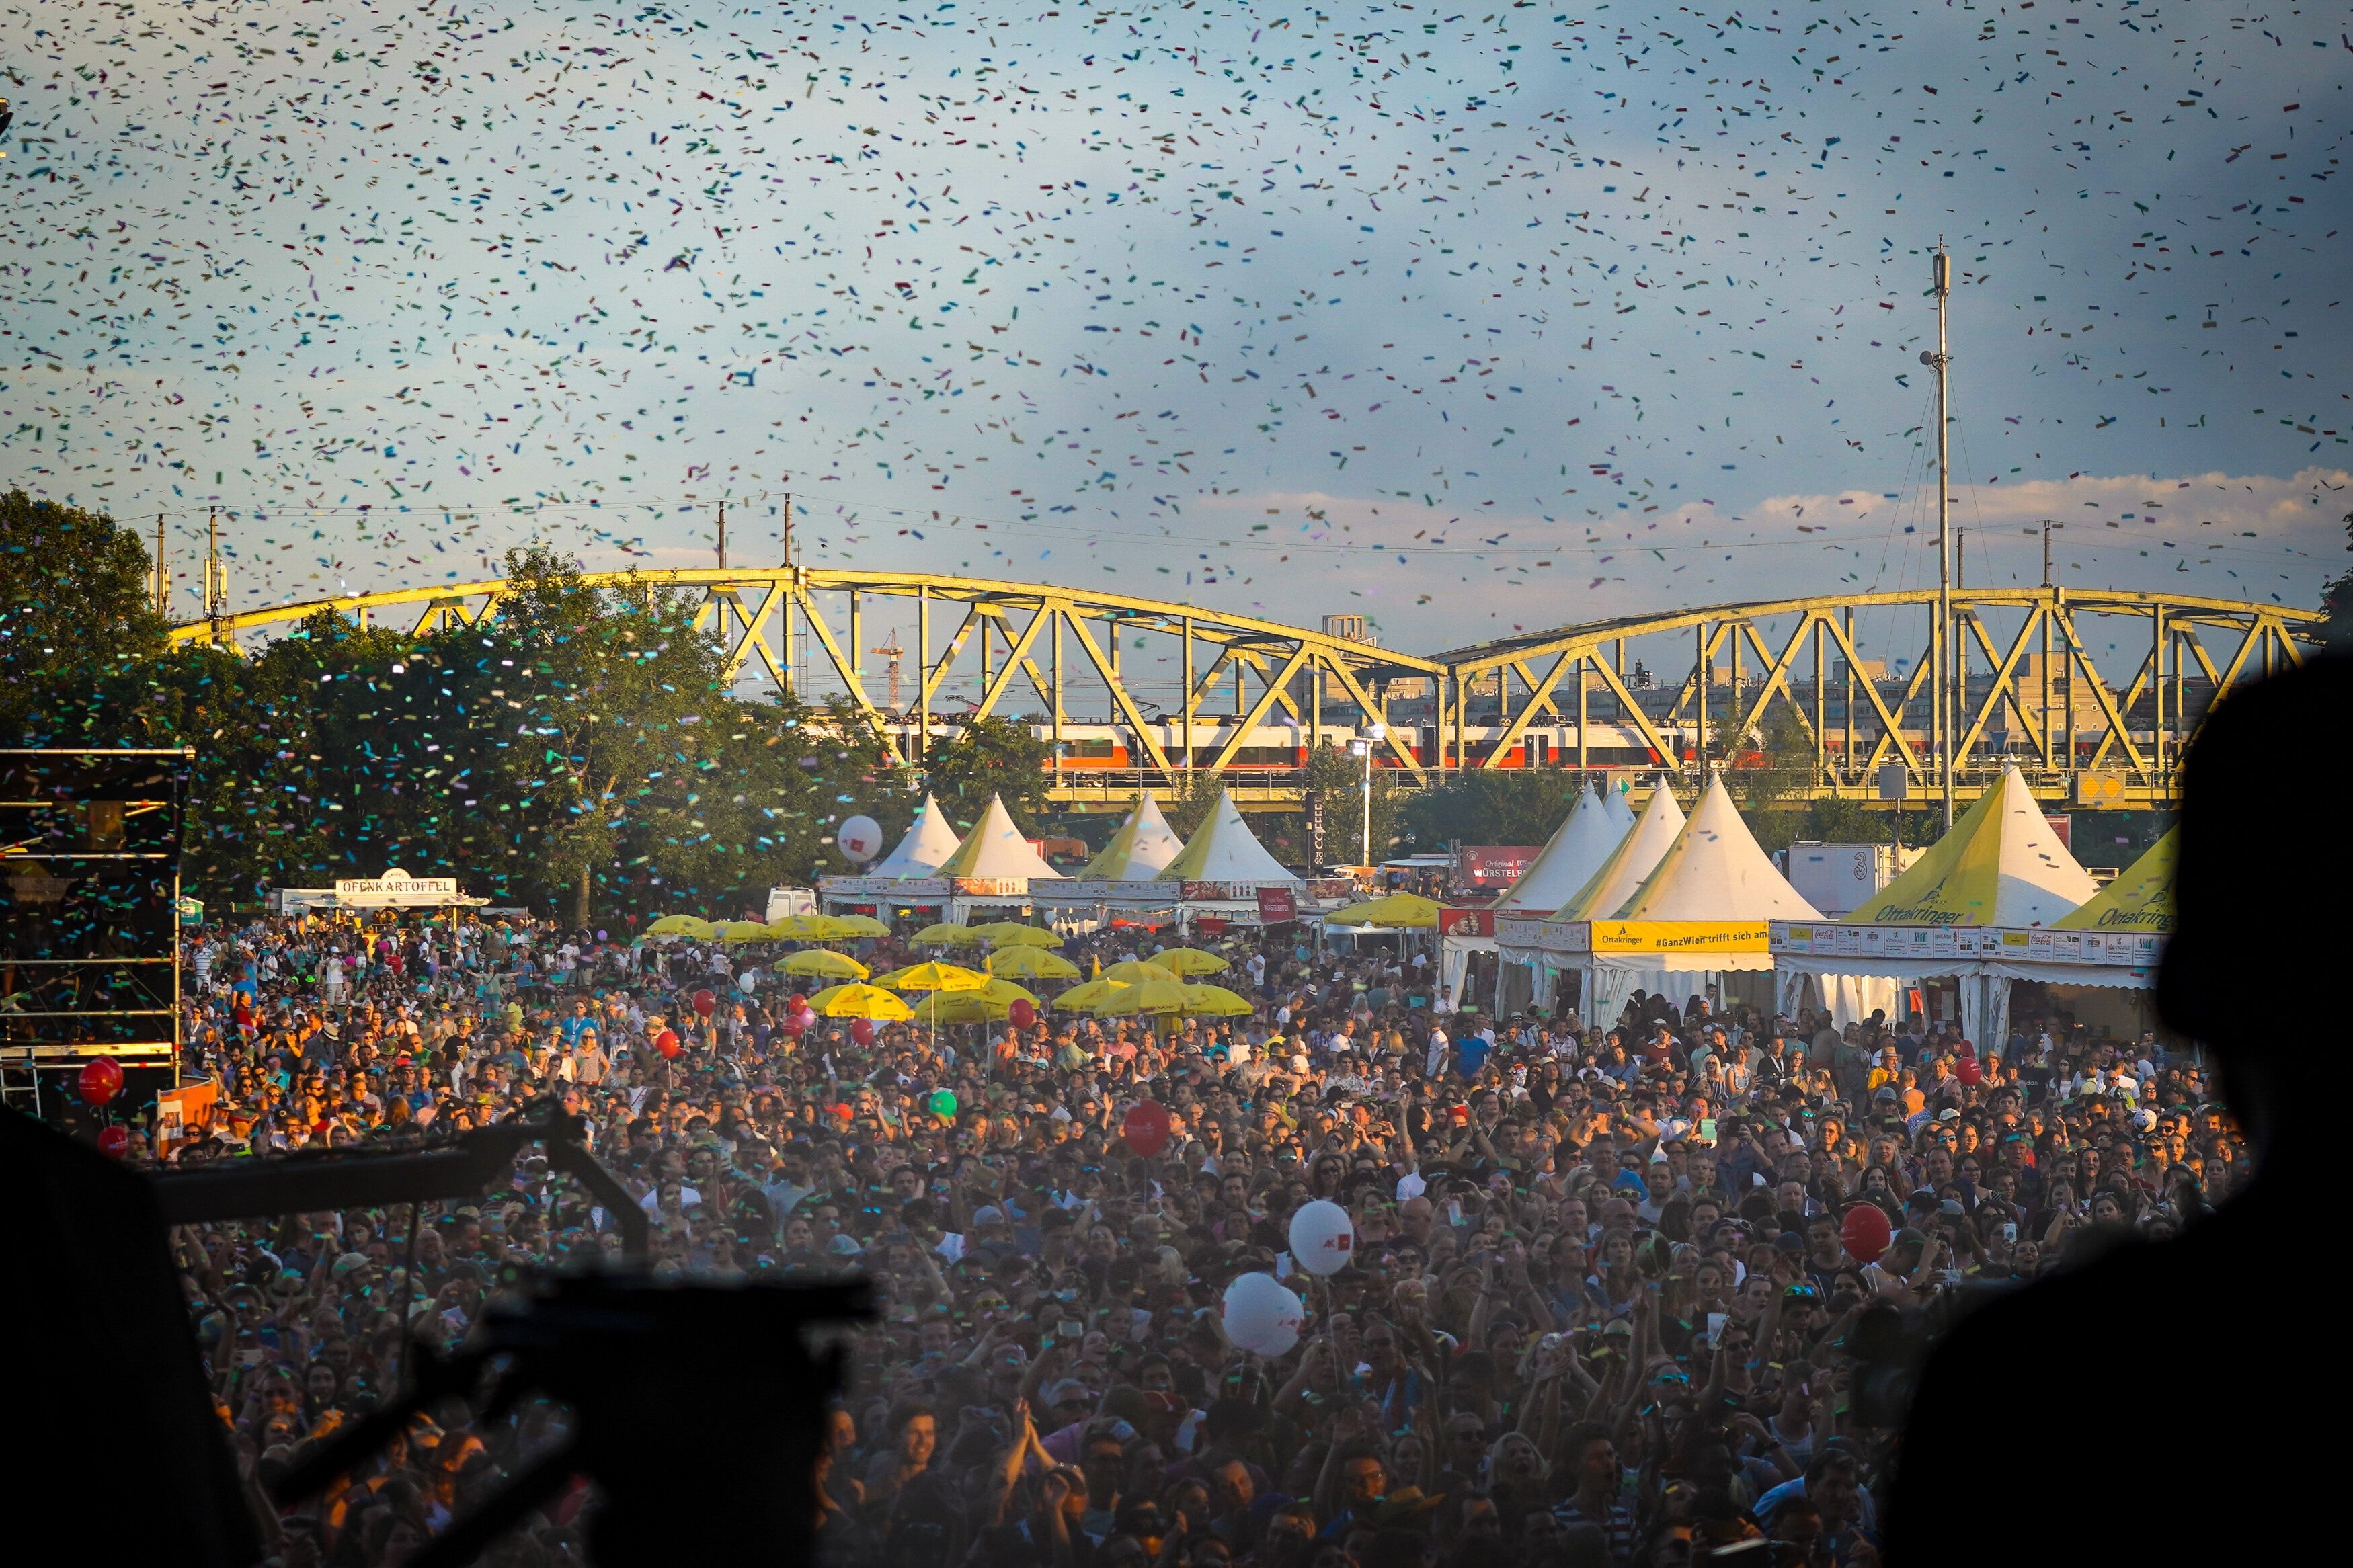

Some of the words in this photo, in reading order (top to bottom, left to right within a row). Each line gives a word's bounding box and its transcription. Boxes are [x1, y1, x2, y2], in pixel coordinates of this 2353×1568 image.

[1314, 804, 1323, 850] COFFEE
[1485, 860, 1514, 868] Original
[1473, 868, 1525, 877] WÜRSTELB
[343, 881, 450, 893] OFENKARTOFFEL
[1874, 905, 1964, 925] Ottakringer
[2097, 907, 2172, 930] Ottakring
[1602, 935, 1643, 945] Ottakringer
[1656, 936, 1705, 948] #GanzWien
[1708, 932, 1730, 942] trifft
[1733, 932, 1751, 941] sich
[1754, 931, 1767, 939] am
